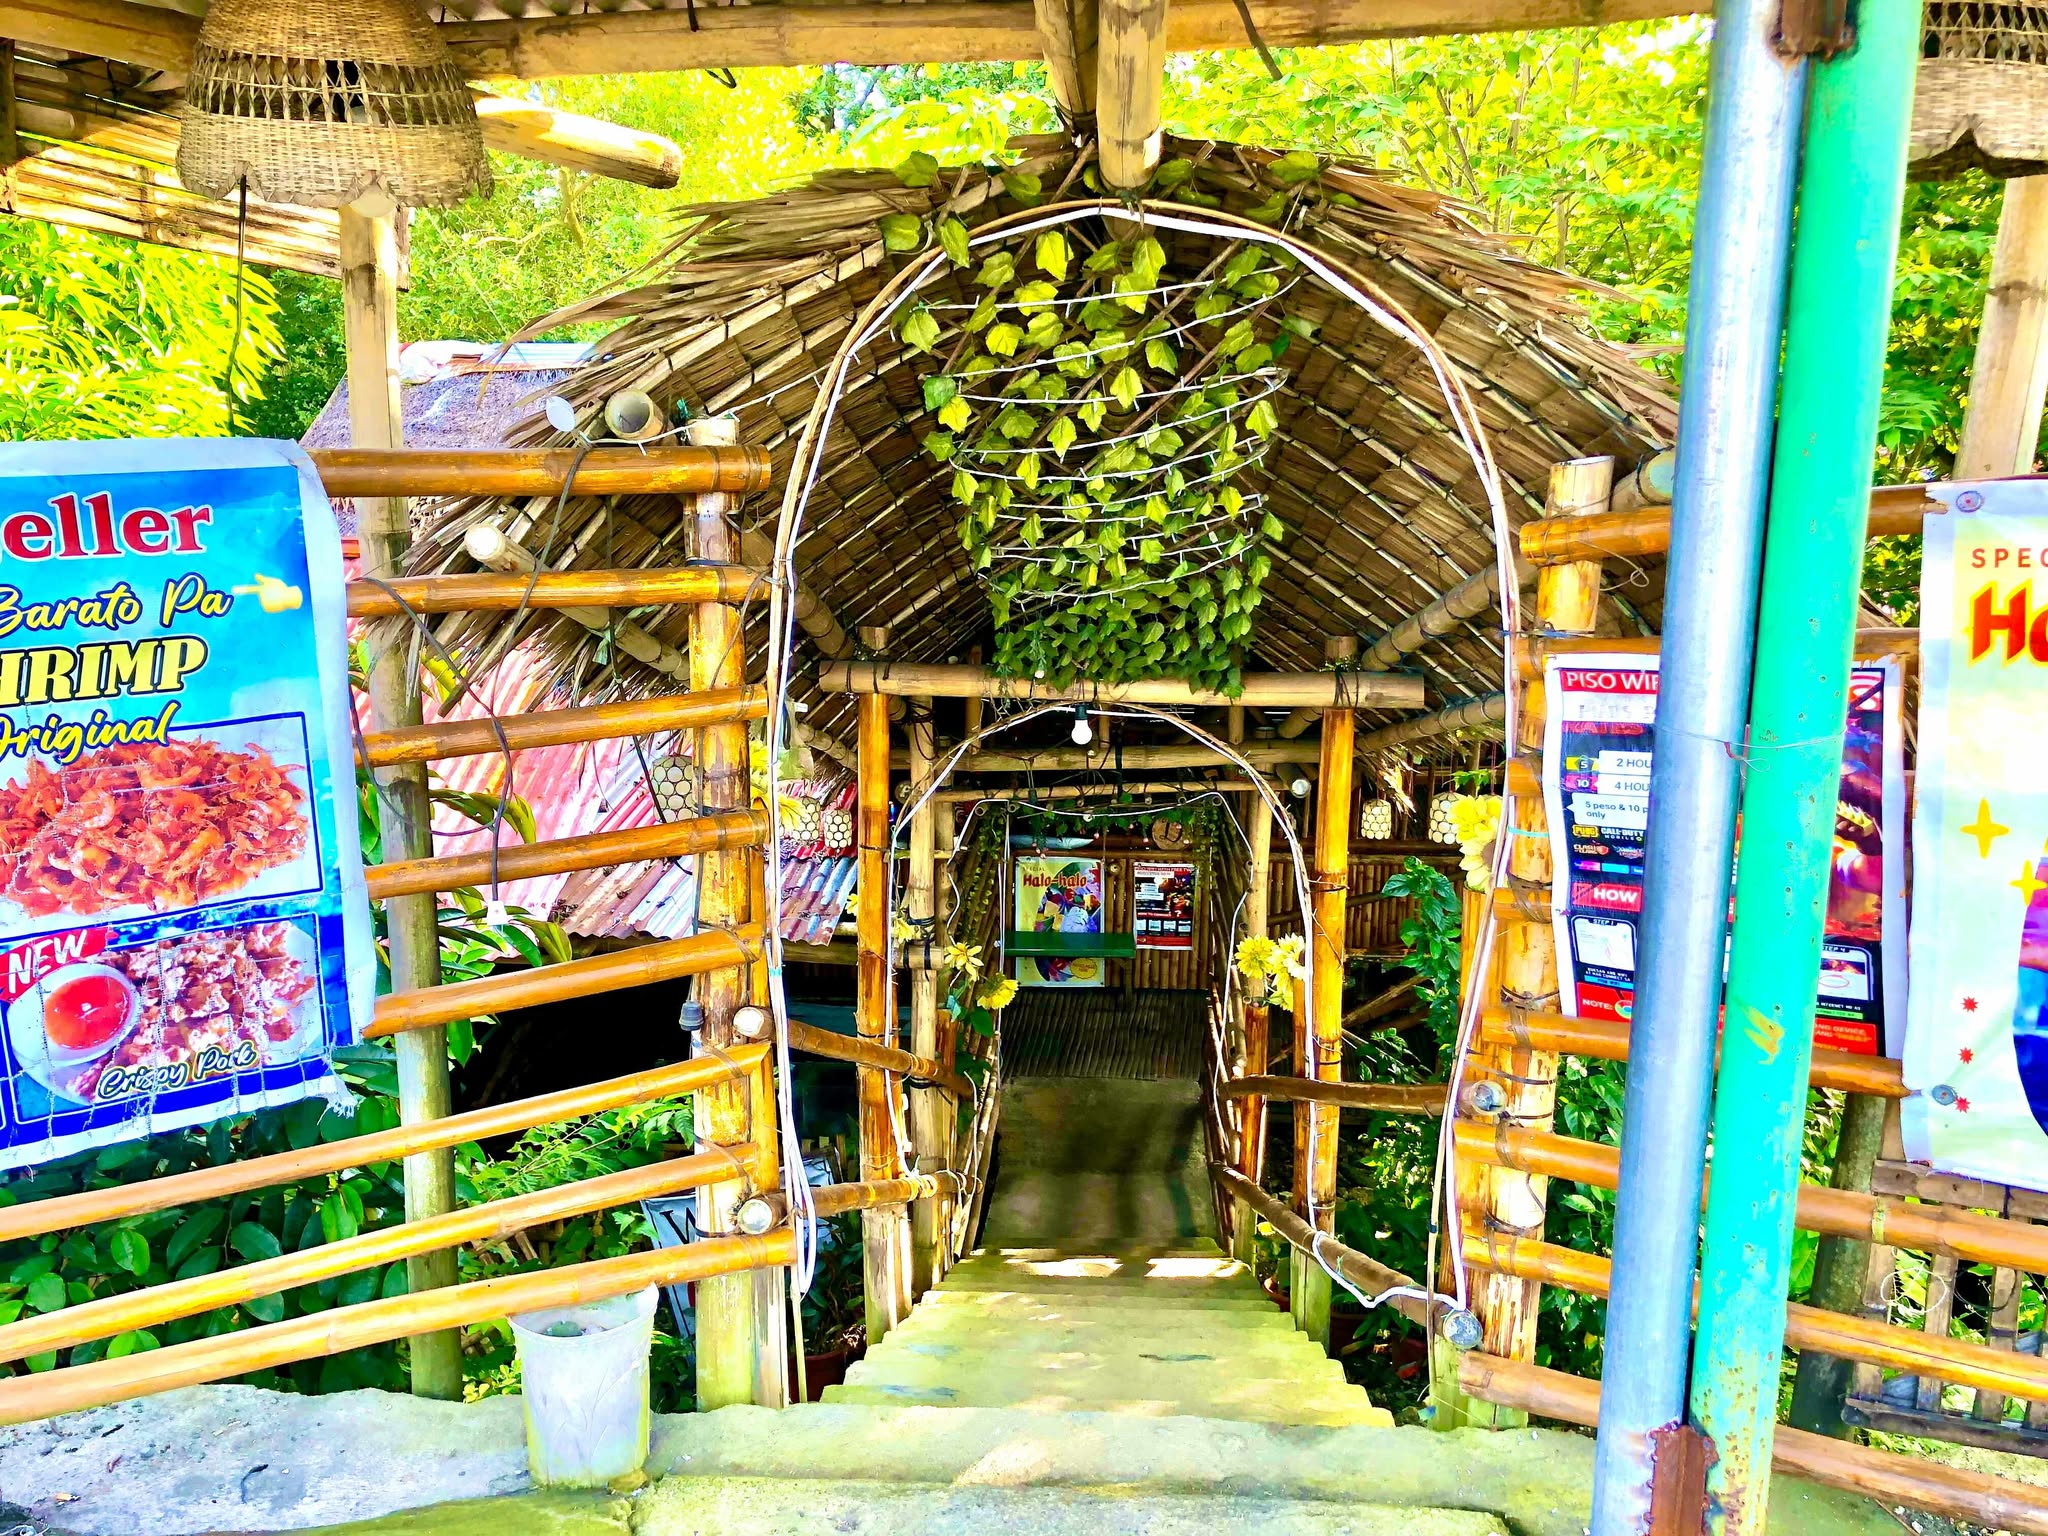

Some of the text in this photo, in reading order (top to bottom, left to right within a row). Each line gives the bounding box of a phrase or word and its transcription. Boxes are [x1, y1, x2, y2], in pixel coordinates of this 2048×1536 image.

[0, 492, 212, 561] eller
[160, 572, 234, 628] Pa
[1566, 671, 1617, 690] PISO
[1579, 760, 1589, 769] 5
[1616, 758, 1624, 767] 2
[1576, 779, 1590, 788] 10
[1614, 781, 1622, 790] 4
[1585, 801, 1591, 809] 5
[1593, 803, 1617, 811] peso
[1618, 803, 1626, 811] &
[1628, 804, 1640, 812] 10
[1586, 810, 1606, 820] only
[1022, 872, 1087, 888] Halo-halo
[1593, 889, 1639, 904] HOW
[1593, 918, 1610, 926] STEP
[7, 930, 88, 994] NEW
[1582, 998, 1613, 1011] NOTE:
[97, 1040, 259, 1099] Crispy Pork
